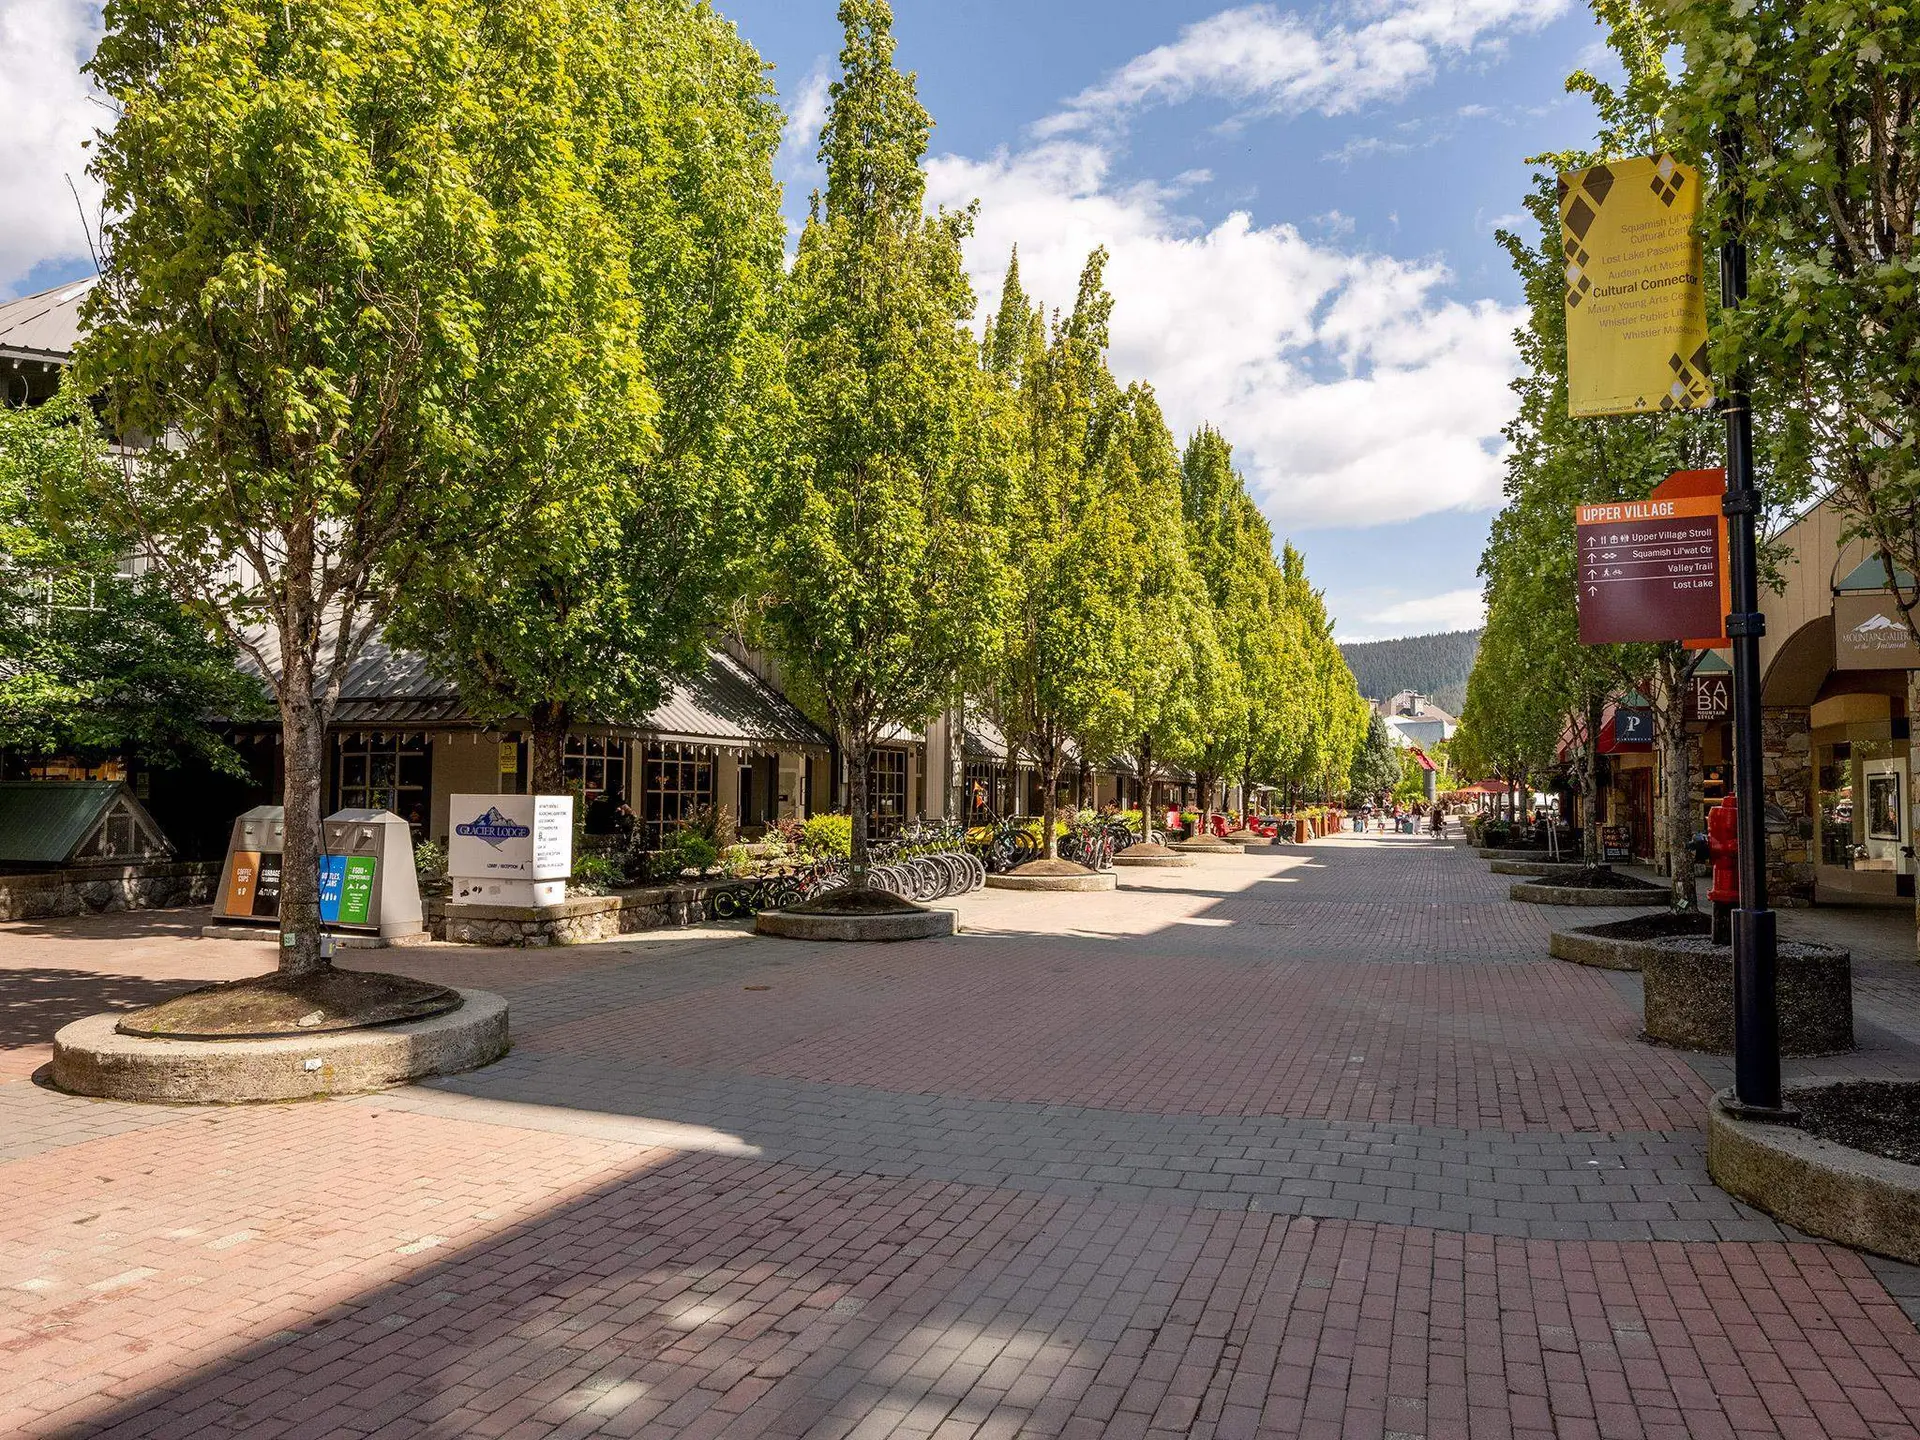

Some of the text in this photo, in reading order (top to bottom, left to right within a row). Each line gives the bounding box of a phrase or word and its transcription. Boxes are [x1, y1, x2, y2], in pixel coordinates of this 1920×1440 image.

[1621, 218, 1667, 234] Squamish
[1630, 231, 1665, 244] Cultural
[1602, 255, 1621, 265] Lost
[1623, 250, 1644, 260] Lake
[1608, 268, 1640, 280] Audain
[1643, 264, 1657, 275] Art
[1593, 272, 1698, 298] Cultural Connector
[1587, 303, 1616, 316] Maury
[1618, 297, 1647, 309] Young
[1649, 294, 1669, 304] Arts
[1600, 314, 1637, 328] Whistler
[1640, 310, 1668, 322] Public
[1622, 325, 1702, 341] Whistler Museum
[1583, 501, 1674, 522] UPPER VILLAGE
[1632, 528, 1712, 543] Upper Village Stroll
[1632, 545, 1712, 559] Squamish Lil'wat Ctr
[1667, 562, 1713, 573] Valley Trail
[1673, 579, 1713, 589] Lost Lake
[1842, 631, 1881, 643] MOUNTAIN
[1697, 677, 1727, 696] KA
[1697, 695, 1728, 711] BN
[1627, 716, 1640, 732] P
[459, 825, 527, 837] GLACIER LODGE
